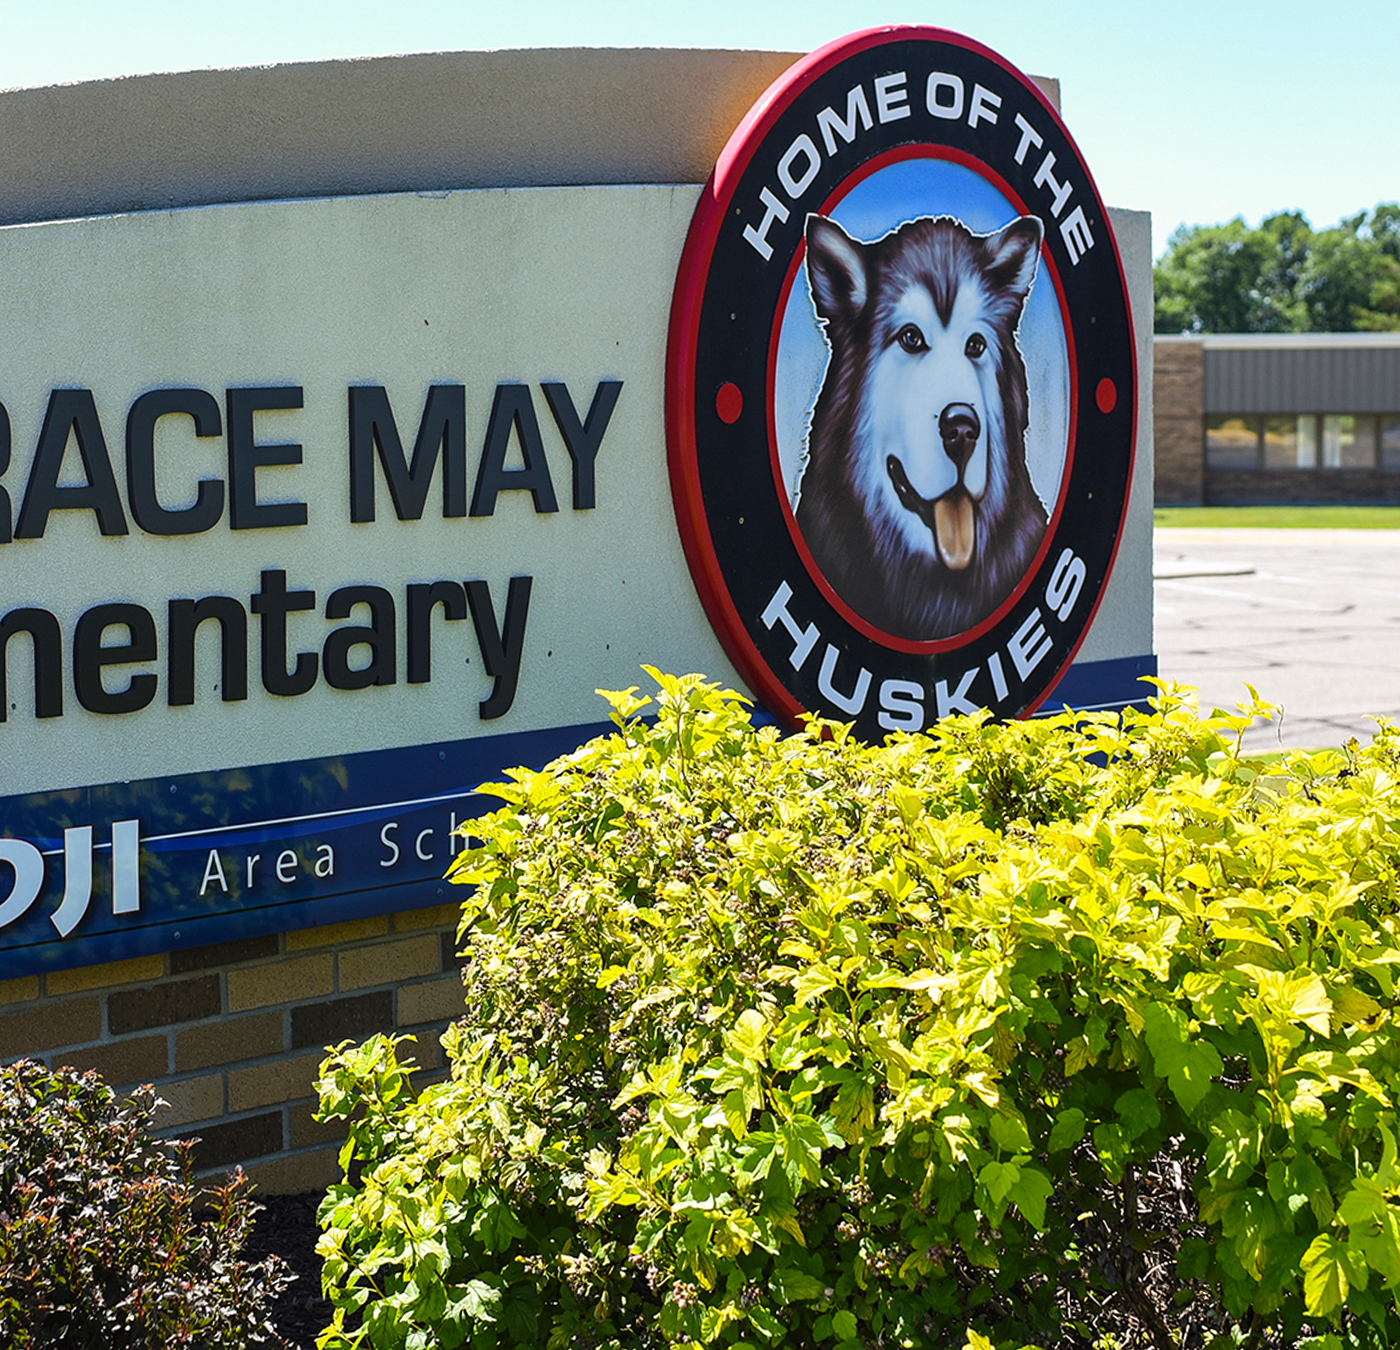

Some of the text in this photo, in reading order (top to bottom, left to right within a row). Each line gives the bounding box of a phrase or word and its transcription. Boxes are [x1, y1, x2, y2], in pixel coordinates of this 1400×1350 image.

[742, 71, 1095, 266] HOME OF THE
[347, 380, 624, 524] MAY
[759, 548, 1087, 733] HUSKIES
[199, 843, 336, 895] Area
[379, 811, 472, 868] Sch
